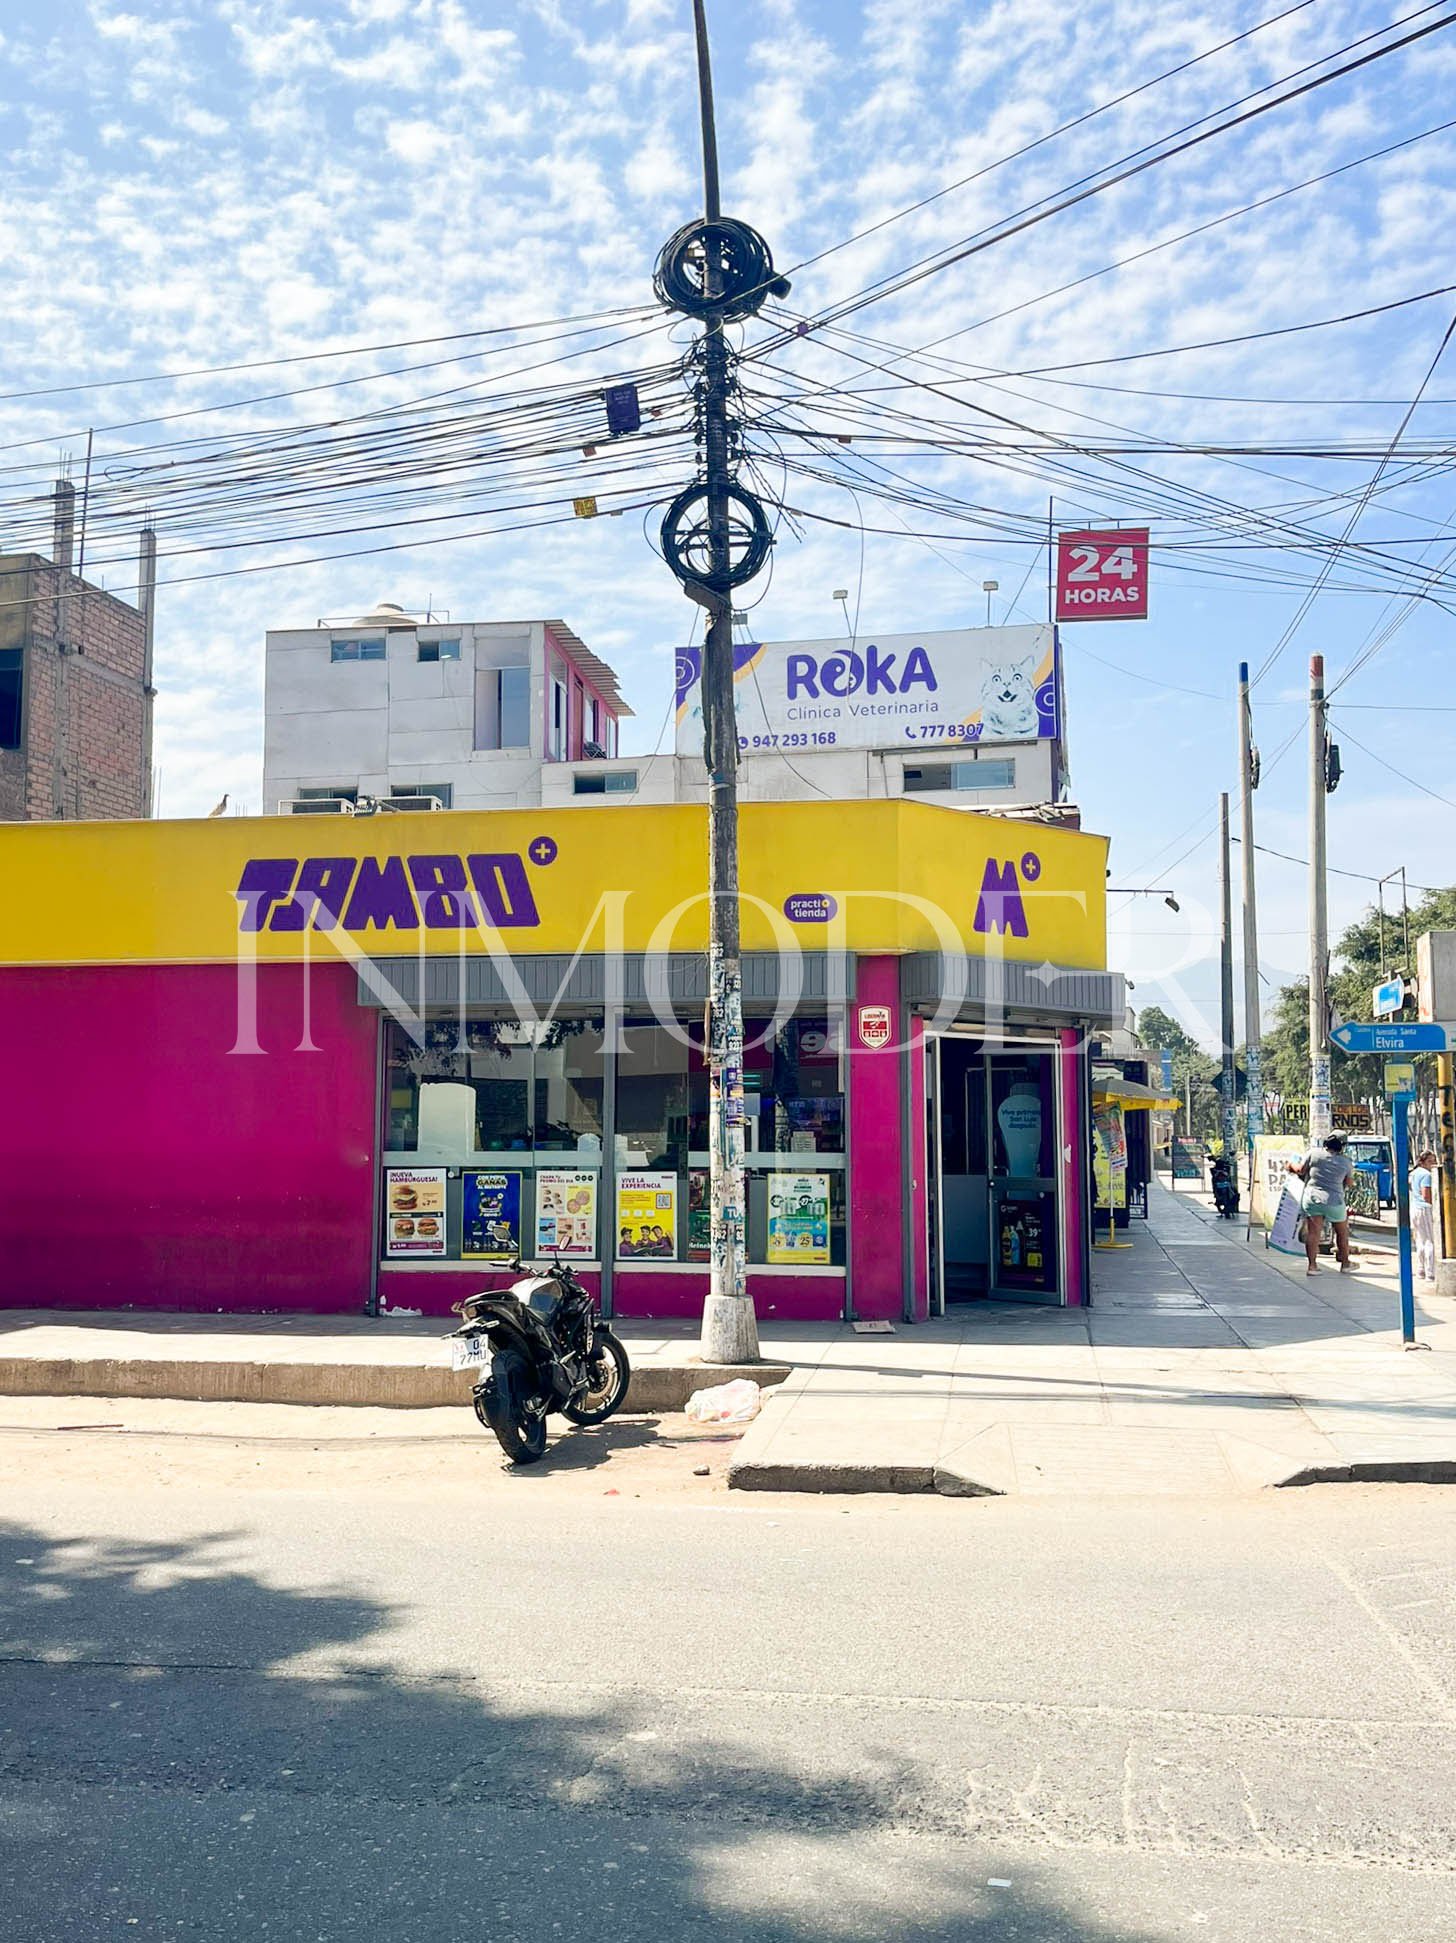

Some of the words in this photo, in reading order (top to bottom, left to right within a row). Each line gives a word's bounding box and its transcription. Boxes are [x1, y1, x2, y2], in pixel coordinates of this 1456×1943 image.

[1067, 545, 1138, 582] 24
[1064, 586, 1140, 604] HORAS
[787, 706, 841, 720] Clínica
[849, 700, 939, 717] Veterinaria
[920, 724, 945, 738] 777
[948, 723, 984, 737] 8307
[752, 734, 778, 747] 947
[782, 733, 807, 746] 293
[811, 732, 836, 745] 168
[794, 907, 827, 918] tienda
[1400, 1028, 1417, 1036] Santa
[1375, 1037, 1404, 1049] Elvira
